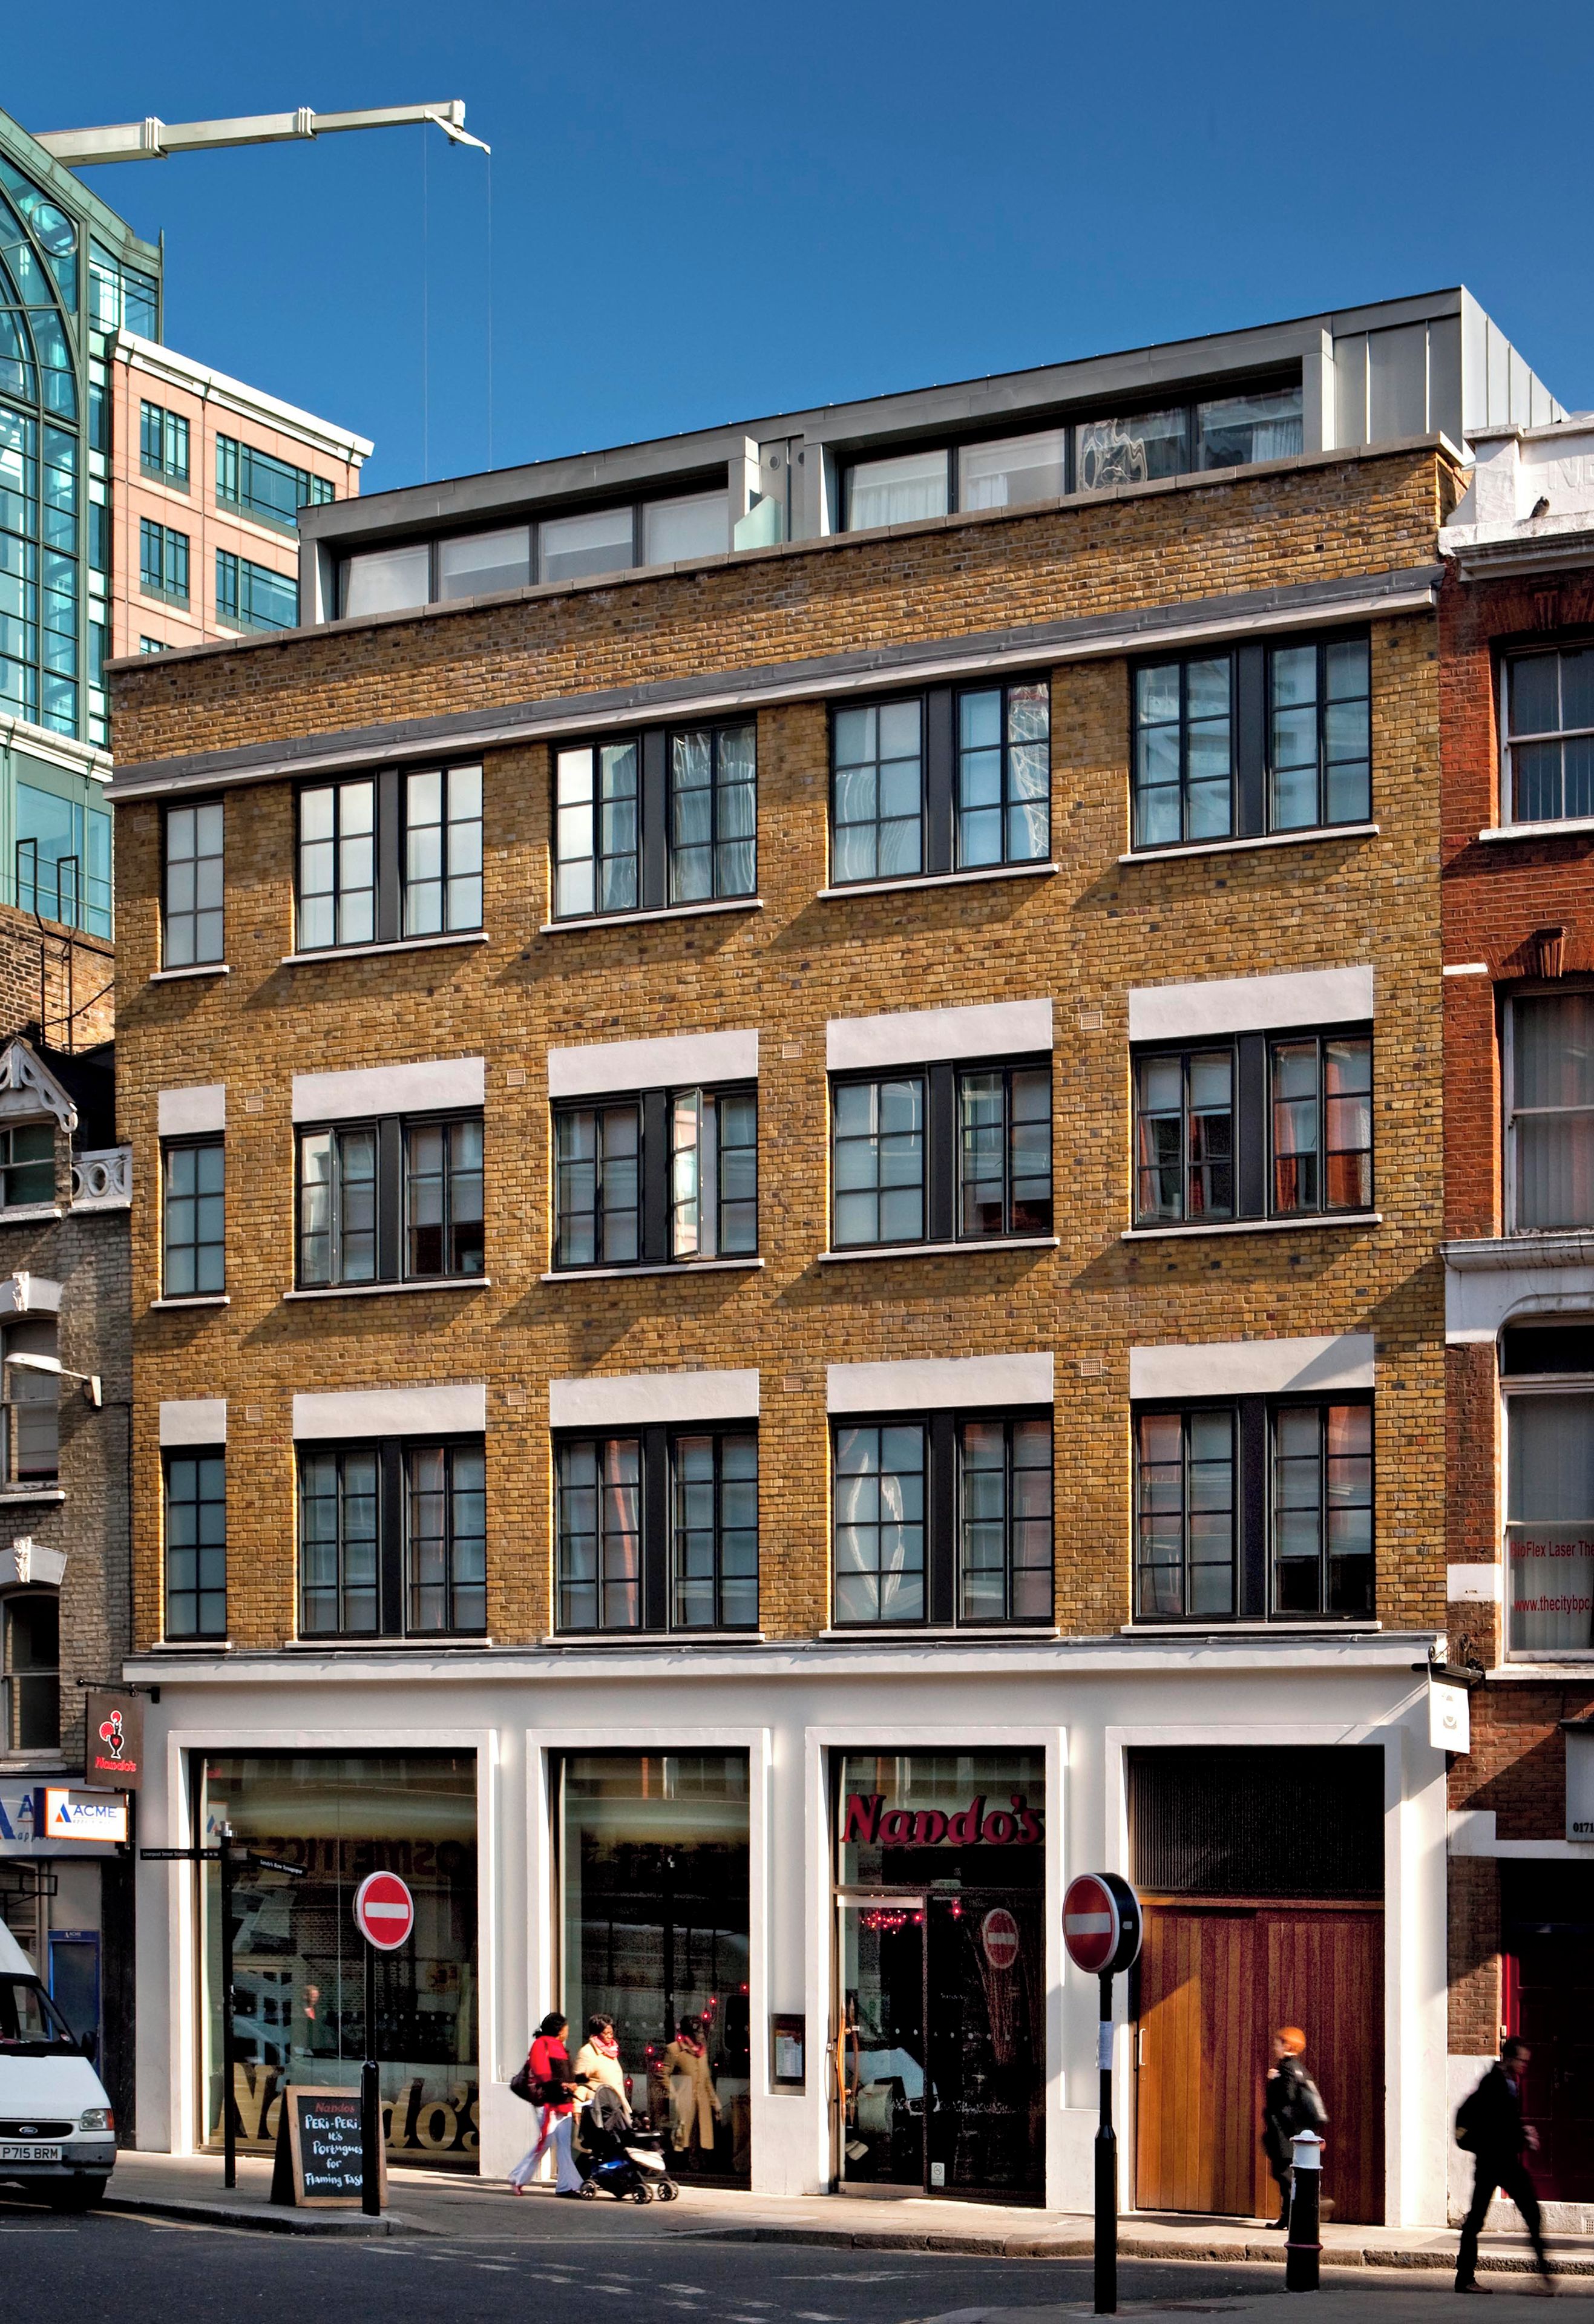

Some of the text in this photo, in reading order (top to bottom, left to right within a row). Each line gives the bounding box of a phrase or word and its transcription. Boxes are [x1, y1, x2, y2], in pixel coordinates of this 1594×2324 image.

[1510, 1541, 1546, 1557] BioFlex
[1549, 1541, 1576, 1557] Laser
[73, 1804, 117, 1818] ACME
[839, 1794, 1046, 1844] Nando's
[2, 2148, 58, 2159] P715 BRM
[326, 2158, 343, 2168] for
[304, 2173, 343, 2188] Flaming
